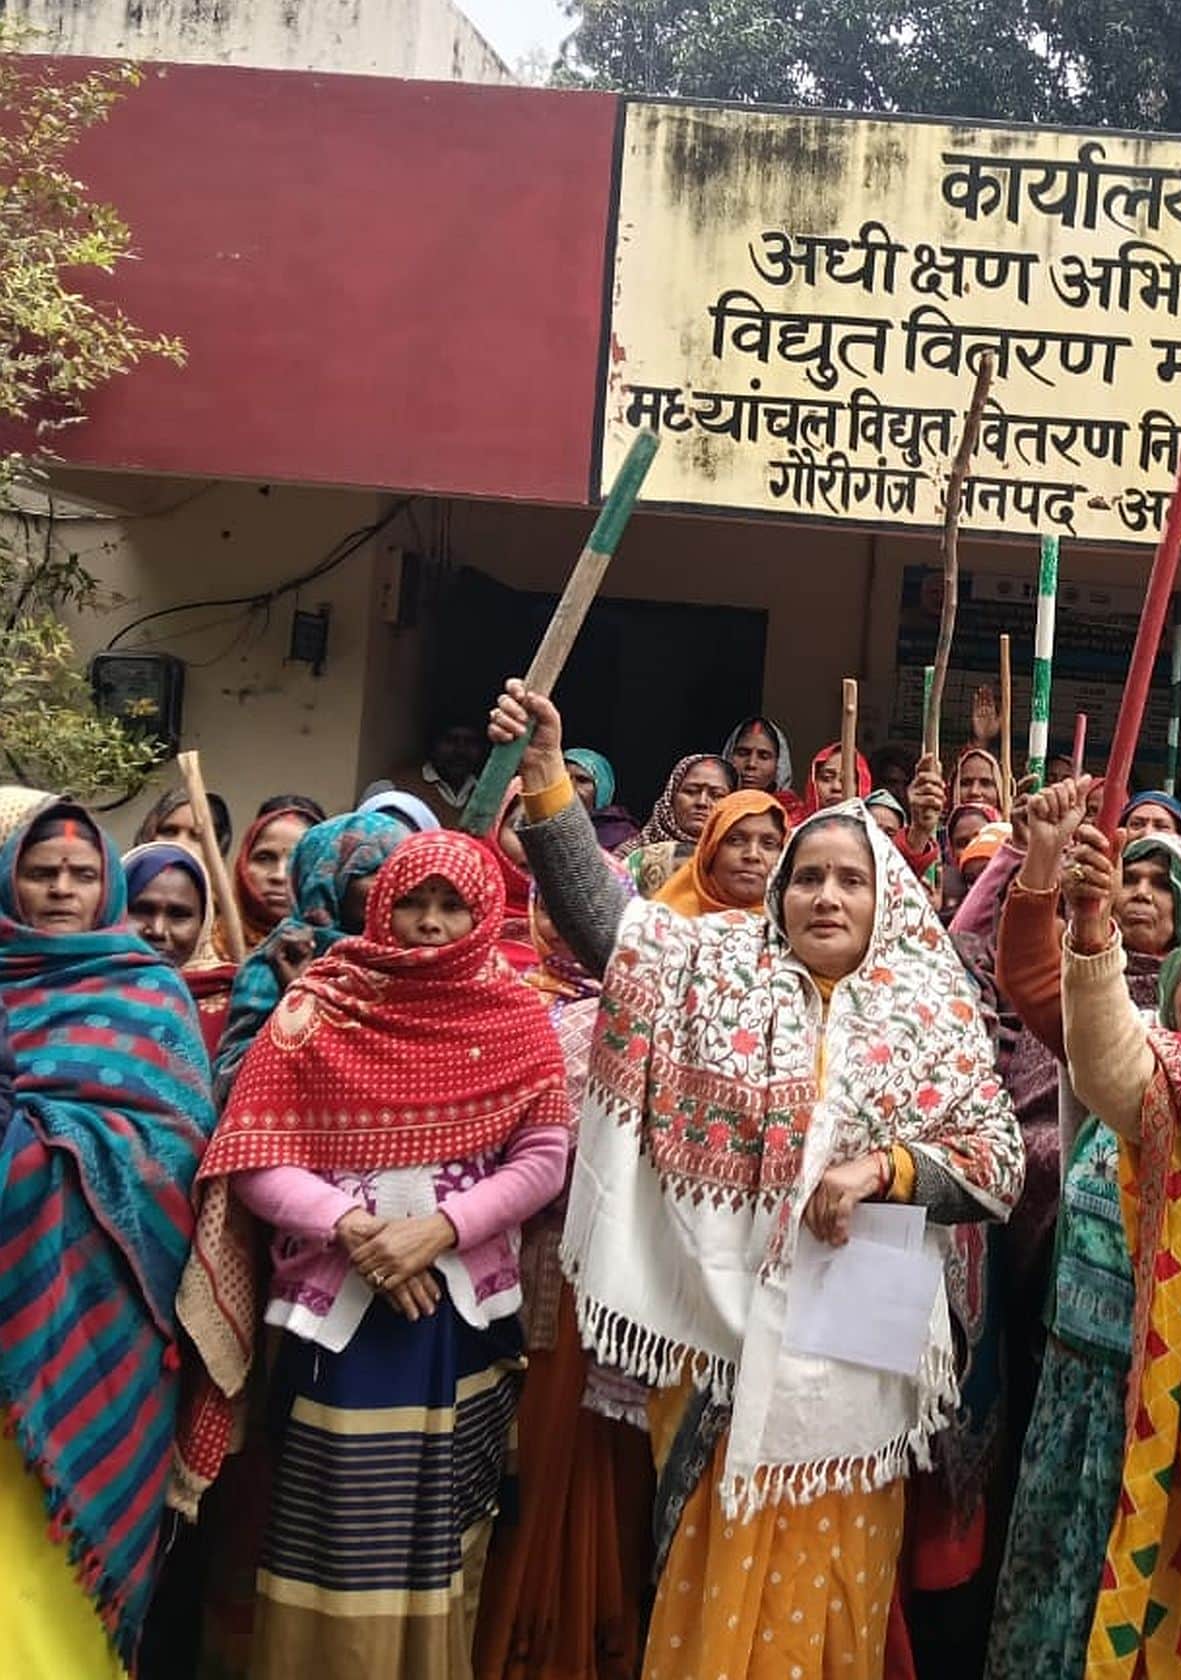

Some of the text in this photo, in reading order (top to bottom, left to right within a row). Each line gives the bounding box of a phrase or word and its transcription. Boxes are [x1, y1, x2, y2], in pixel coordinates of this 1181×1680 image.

[708, 289, 894, 392] विद्युत
[901, 304, 1132, 387] वितरण
[849, 388, 957, 467] विद्युत
[963, 397, 1130, 467] वितरण
[768, 447, 932, 514] गौरीगंज
